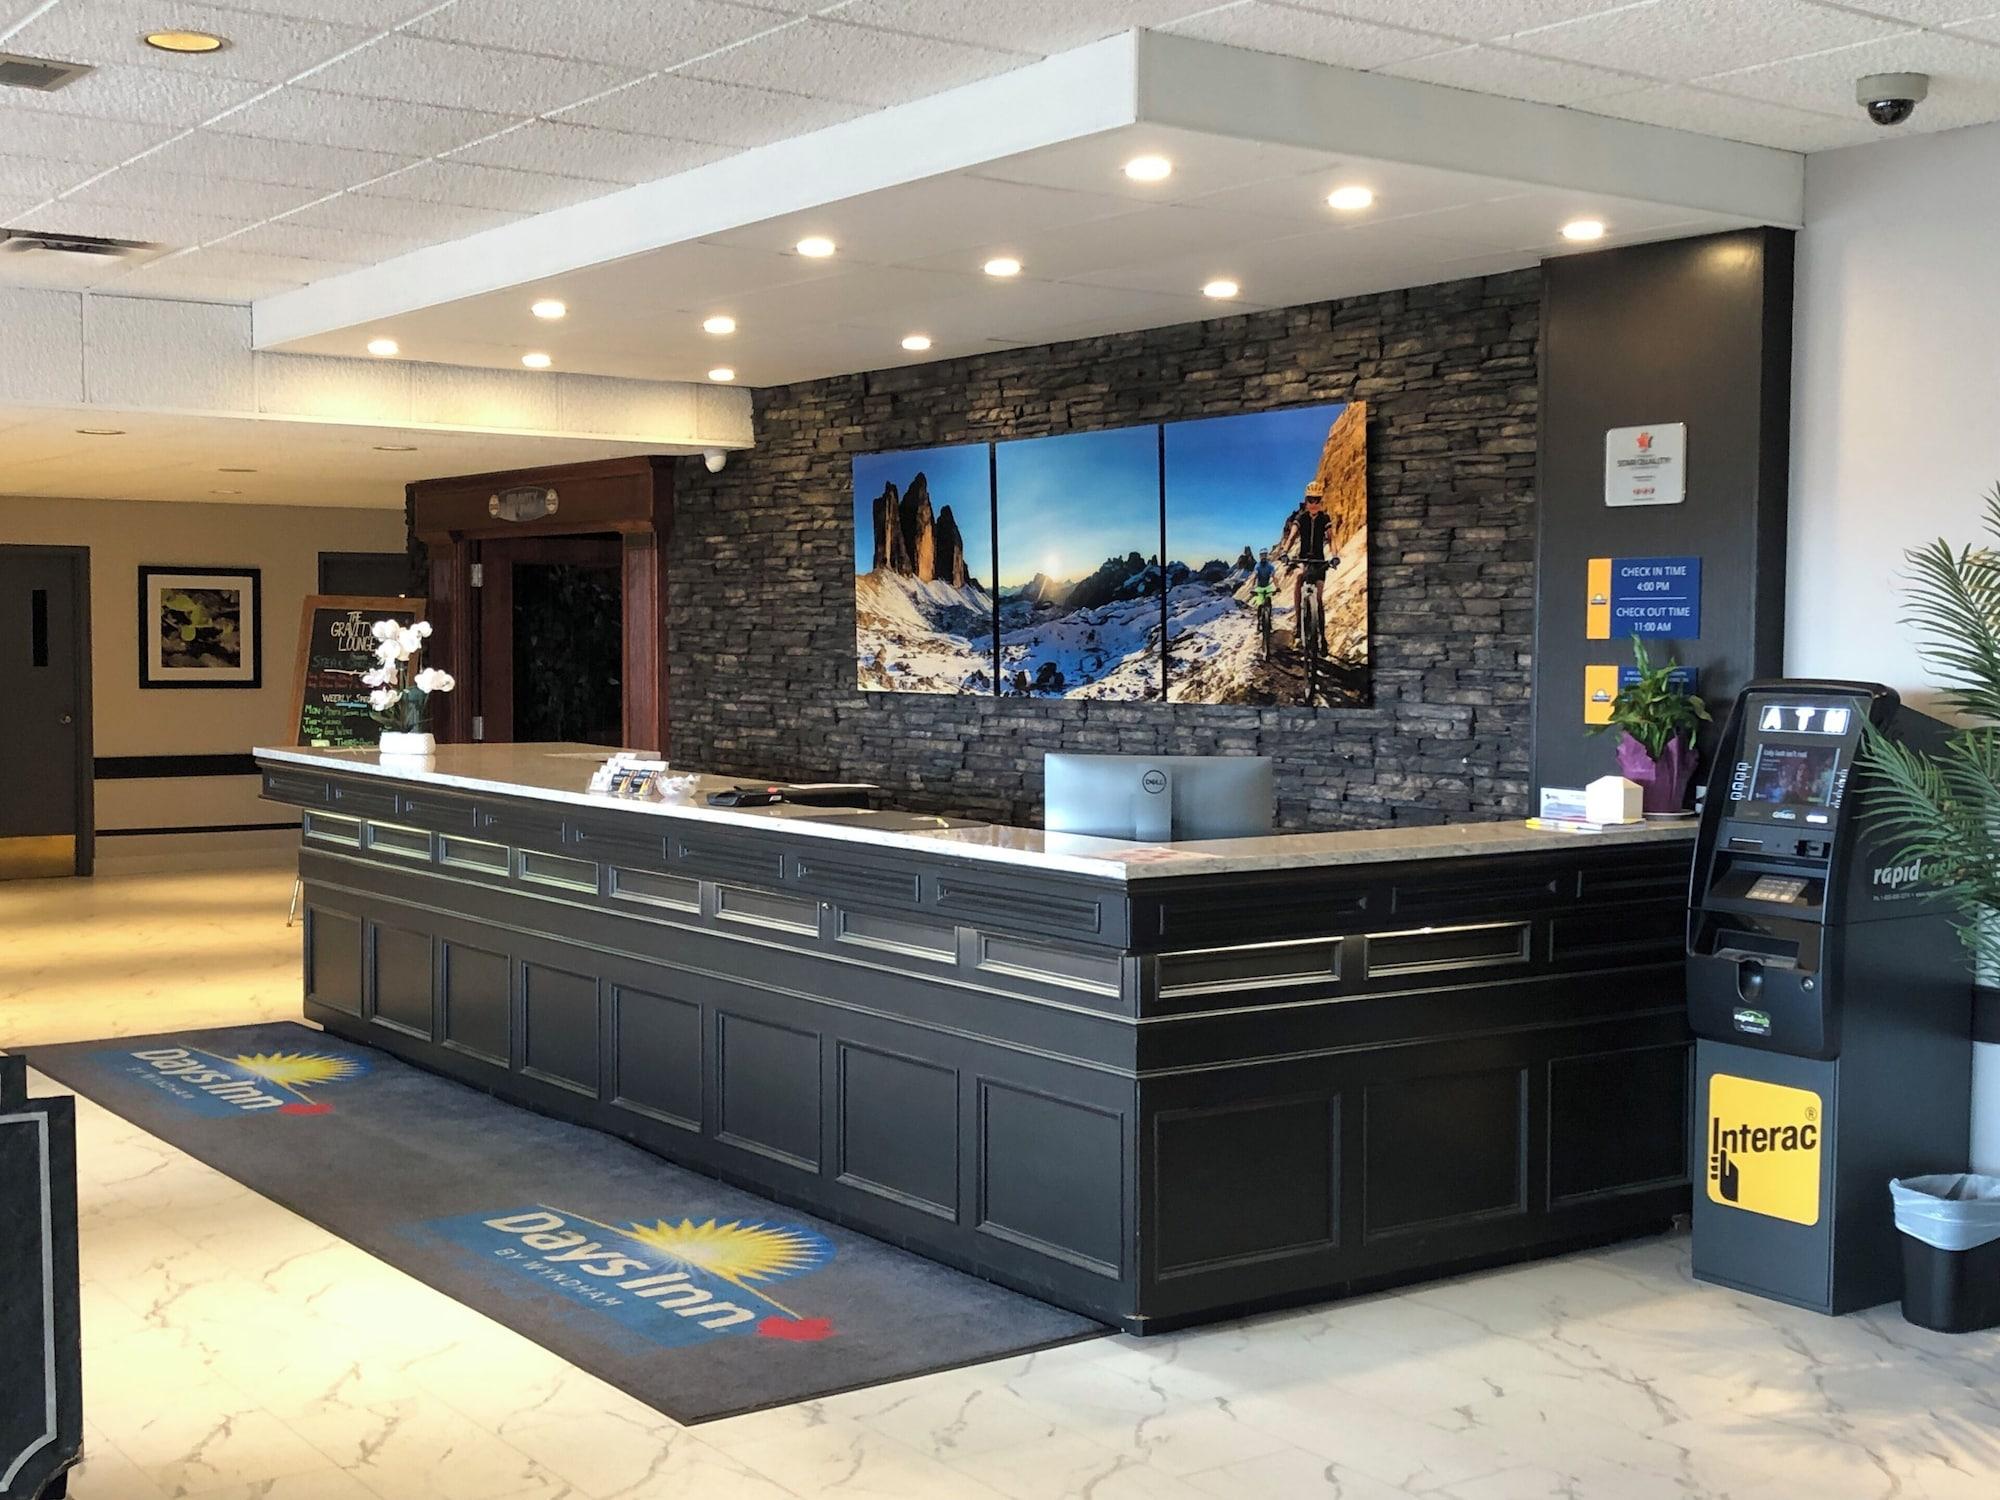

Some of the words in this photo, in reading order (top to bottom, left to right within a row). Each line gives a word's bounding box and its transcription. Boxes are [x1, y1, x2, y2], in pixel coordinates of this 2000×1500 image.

[1621, 567, 1651, 577] CHECK
[1652, 567, 1663, 576] IN
[1664, 566, 1687, 576] TIME
[1637, 582, 1654, 591] 4:00
[1656, 581, 1669, 590] PM
[347, 611, 363, 622] THE
[1616, 607, 1645, 617] CHECK
[1647, 607, 1666, 617] OUT
[1667, 607, 1690, 616] TIME
[1634, 622, 1656, 631] 11:00
[1657, 622, 1672, 631] AM
[338, 636, 377, 651] LOUNGE
[1762, 707, 1847, 733] ATM
[1145, 778, 1164, 786] DELL
[1713, 1117, 1818, 1154] Interac
[494, 1247, 528, 1260] BY
[522, 1260, 625, 1307] WYNDHAM
